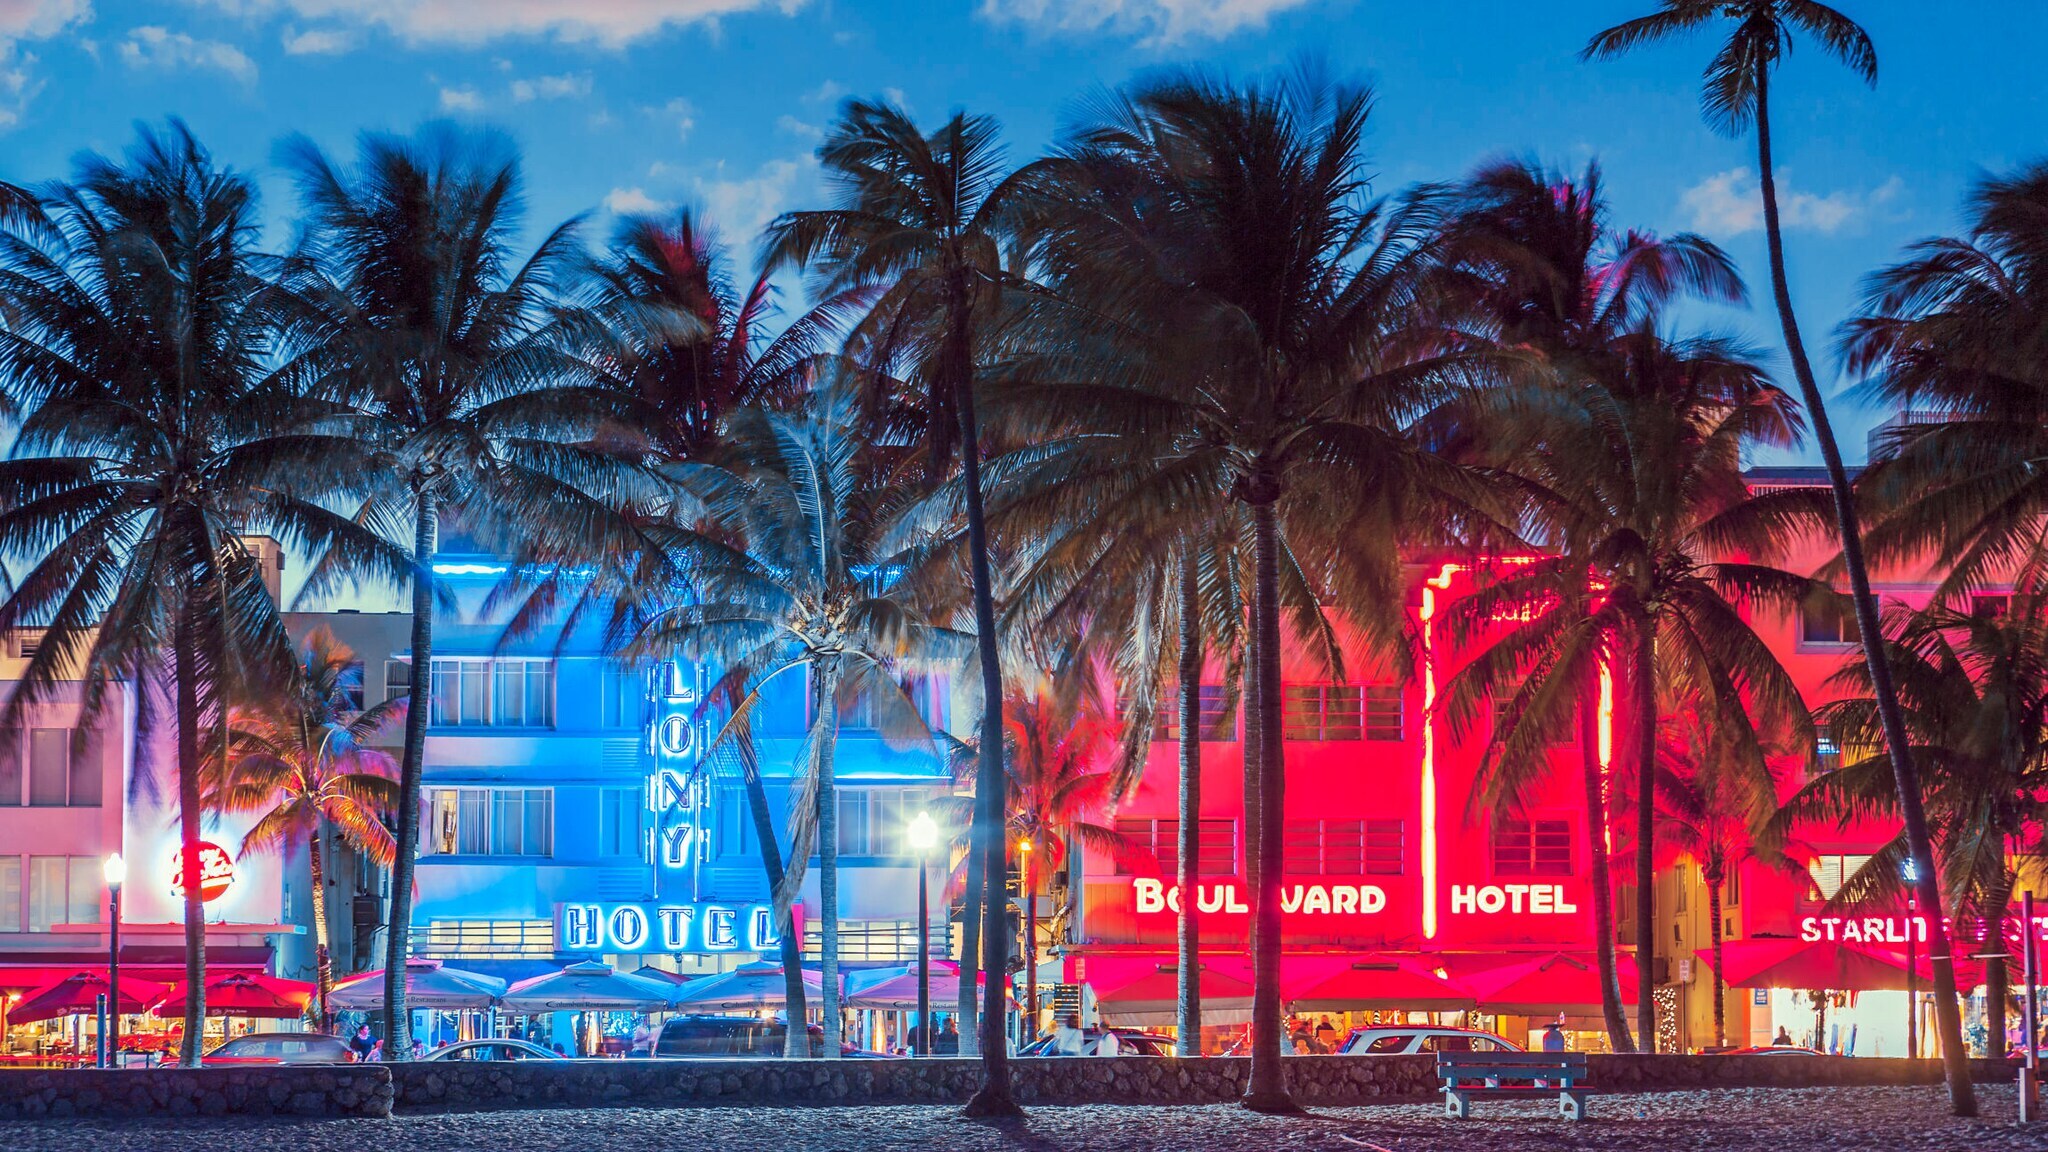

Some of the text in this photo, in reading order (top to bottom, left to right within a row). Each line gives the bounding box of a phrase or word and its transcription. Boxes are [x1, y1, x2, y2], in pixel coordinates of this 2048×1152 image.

[661, 551, 692, 864] LONY
[1133, 878, 1577, 914] BULVARD HOTEL
[567, 908, 782, 947] HOTEL
